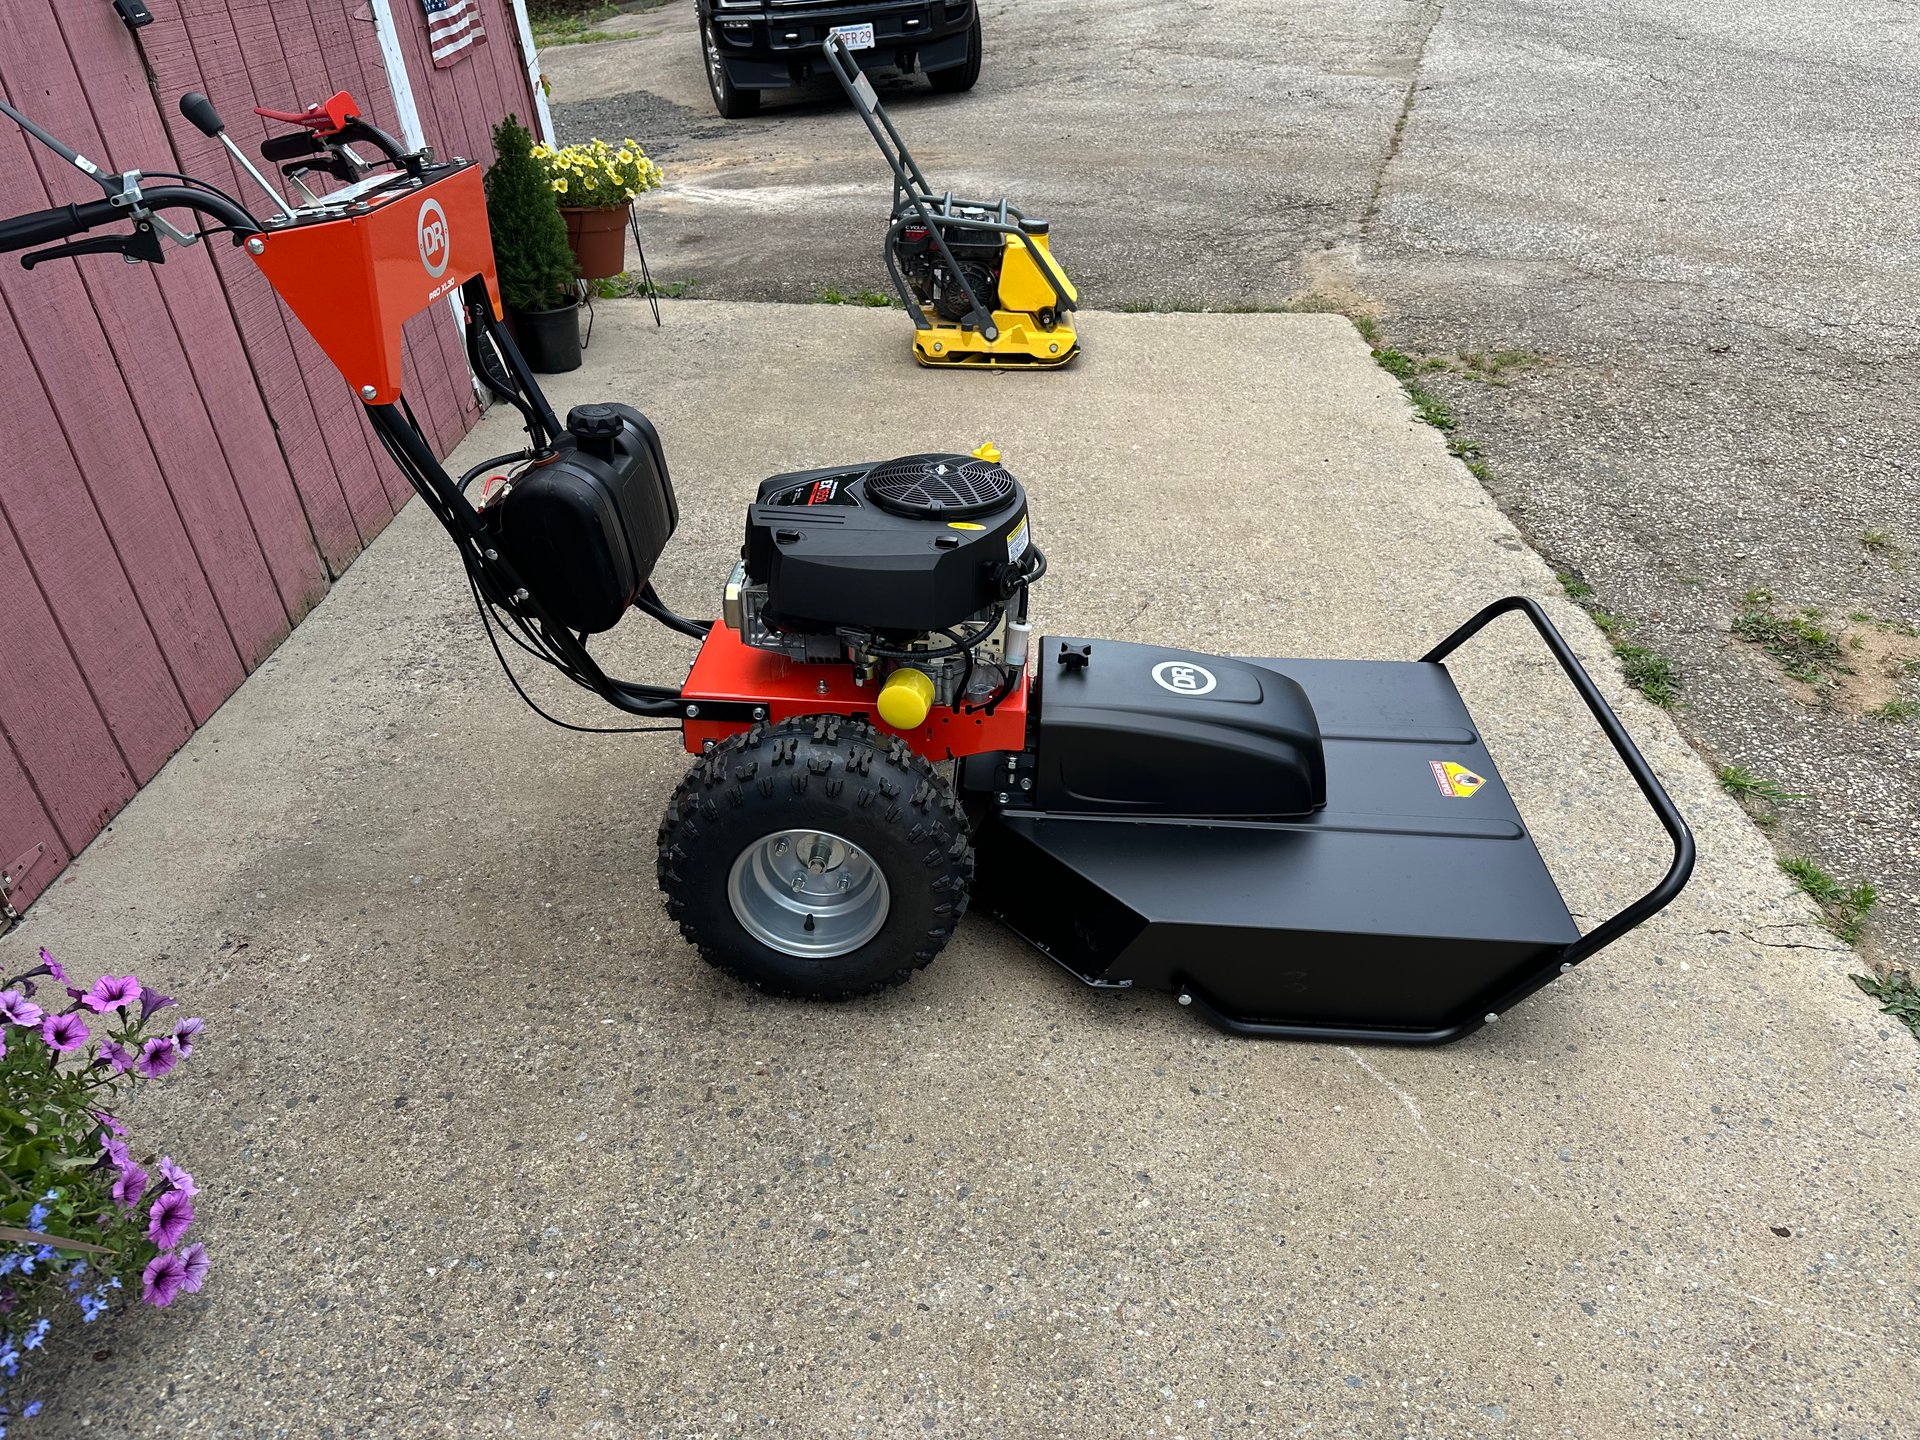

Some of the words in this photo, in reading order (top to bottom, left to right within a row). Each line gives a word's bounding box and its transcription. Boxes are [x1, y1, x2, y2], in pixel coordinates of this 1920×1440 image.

[859, 30, 872, 44] 29
[423, 221, 445, 257] DR
[428, 288, 441, 302] PRO
[1171, 666, 1197, 690] DR
[1433, 763, 1454, 796] DANGER
